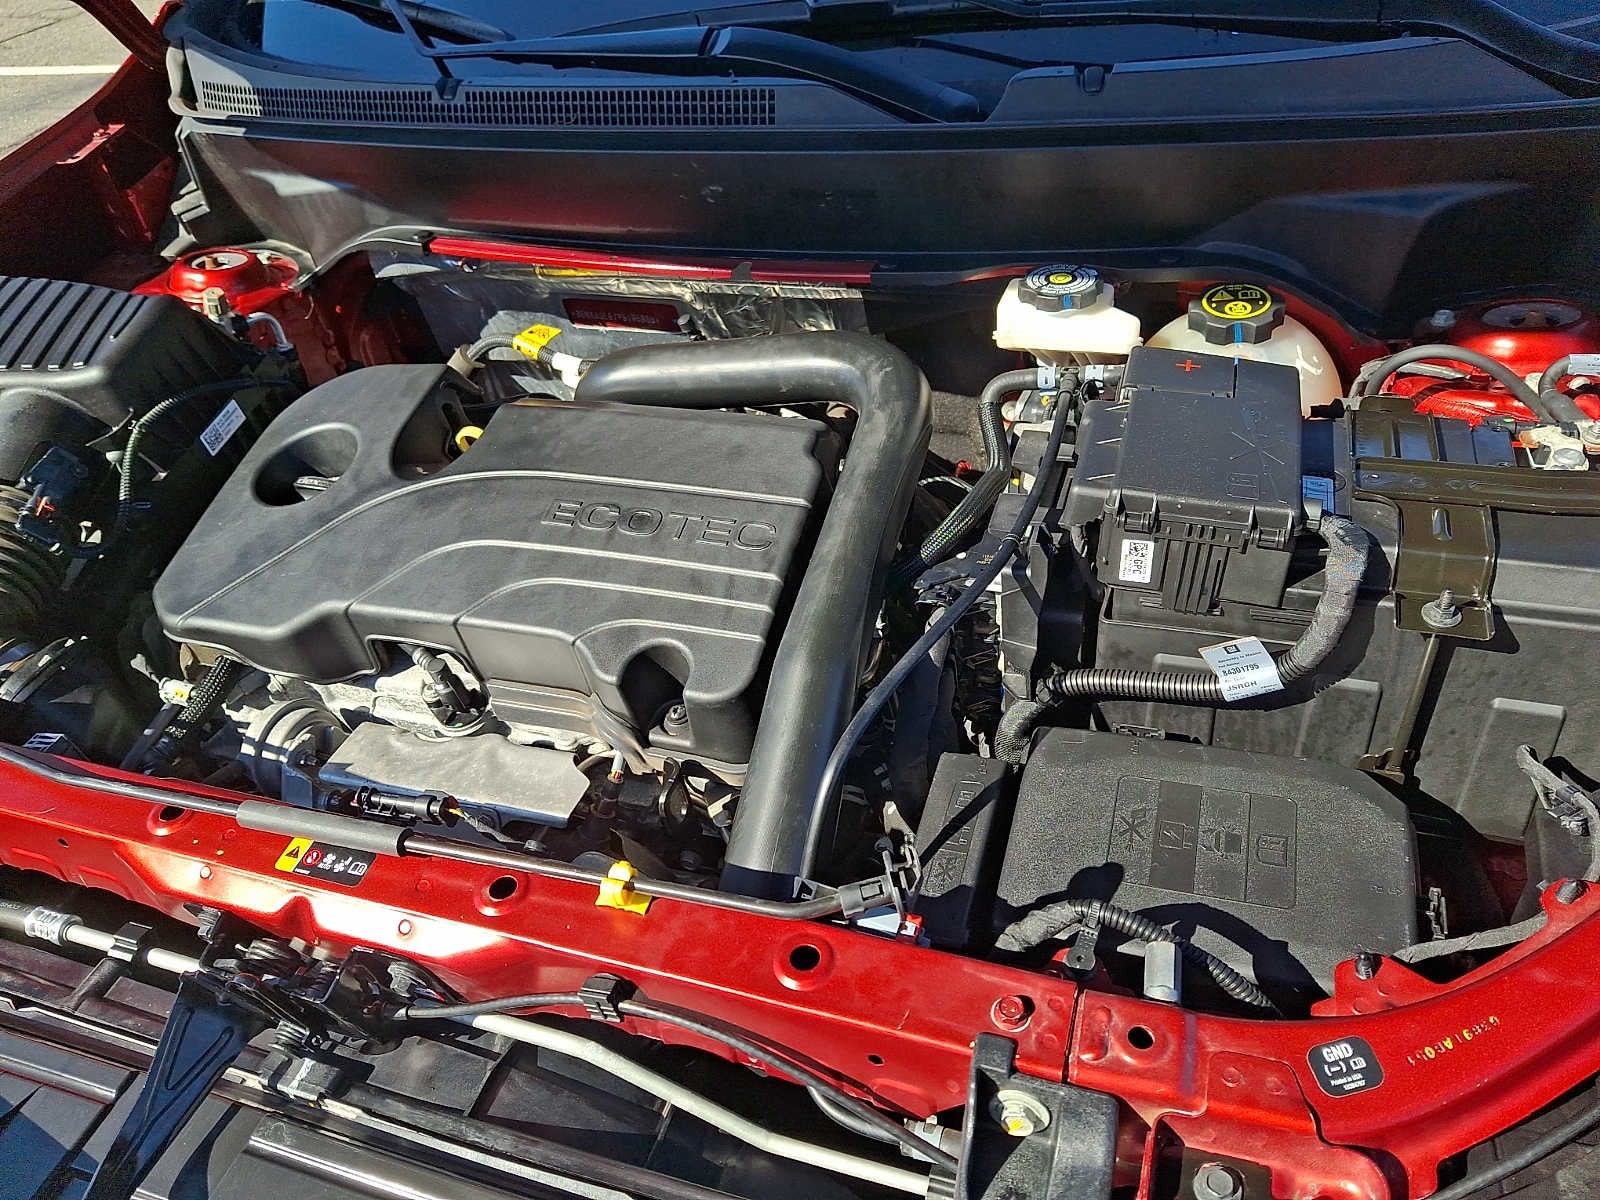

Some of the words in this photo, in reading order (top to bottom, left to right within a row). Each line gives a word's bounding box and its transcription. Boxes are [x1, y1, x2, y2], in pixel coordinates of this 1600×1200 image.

[541, 499, 777, 551] ECOTEC
[1133, 559, 1143, 574] GPC
[1222, 663, 1260, 676] 84301795
[1322, 1043, 1354, 1063] GND
